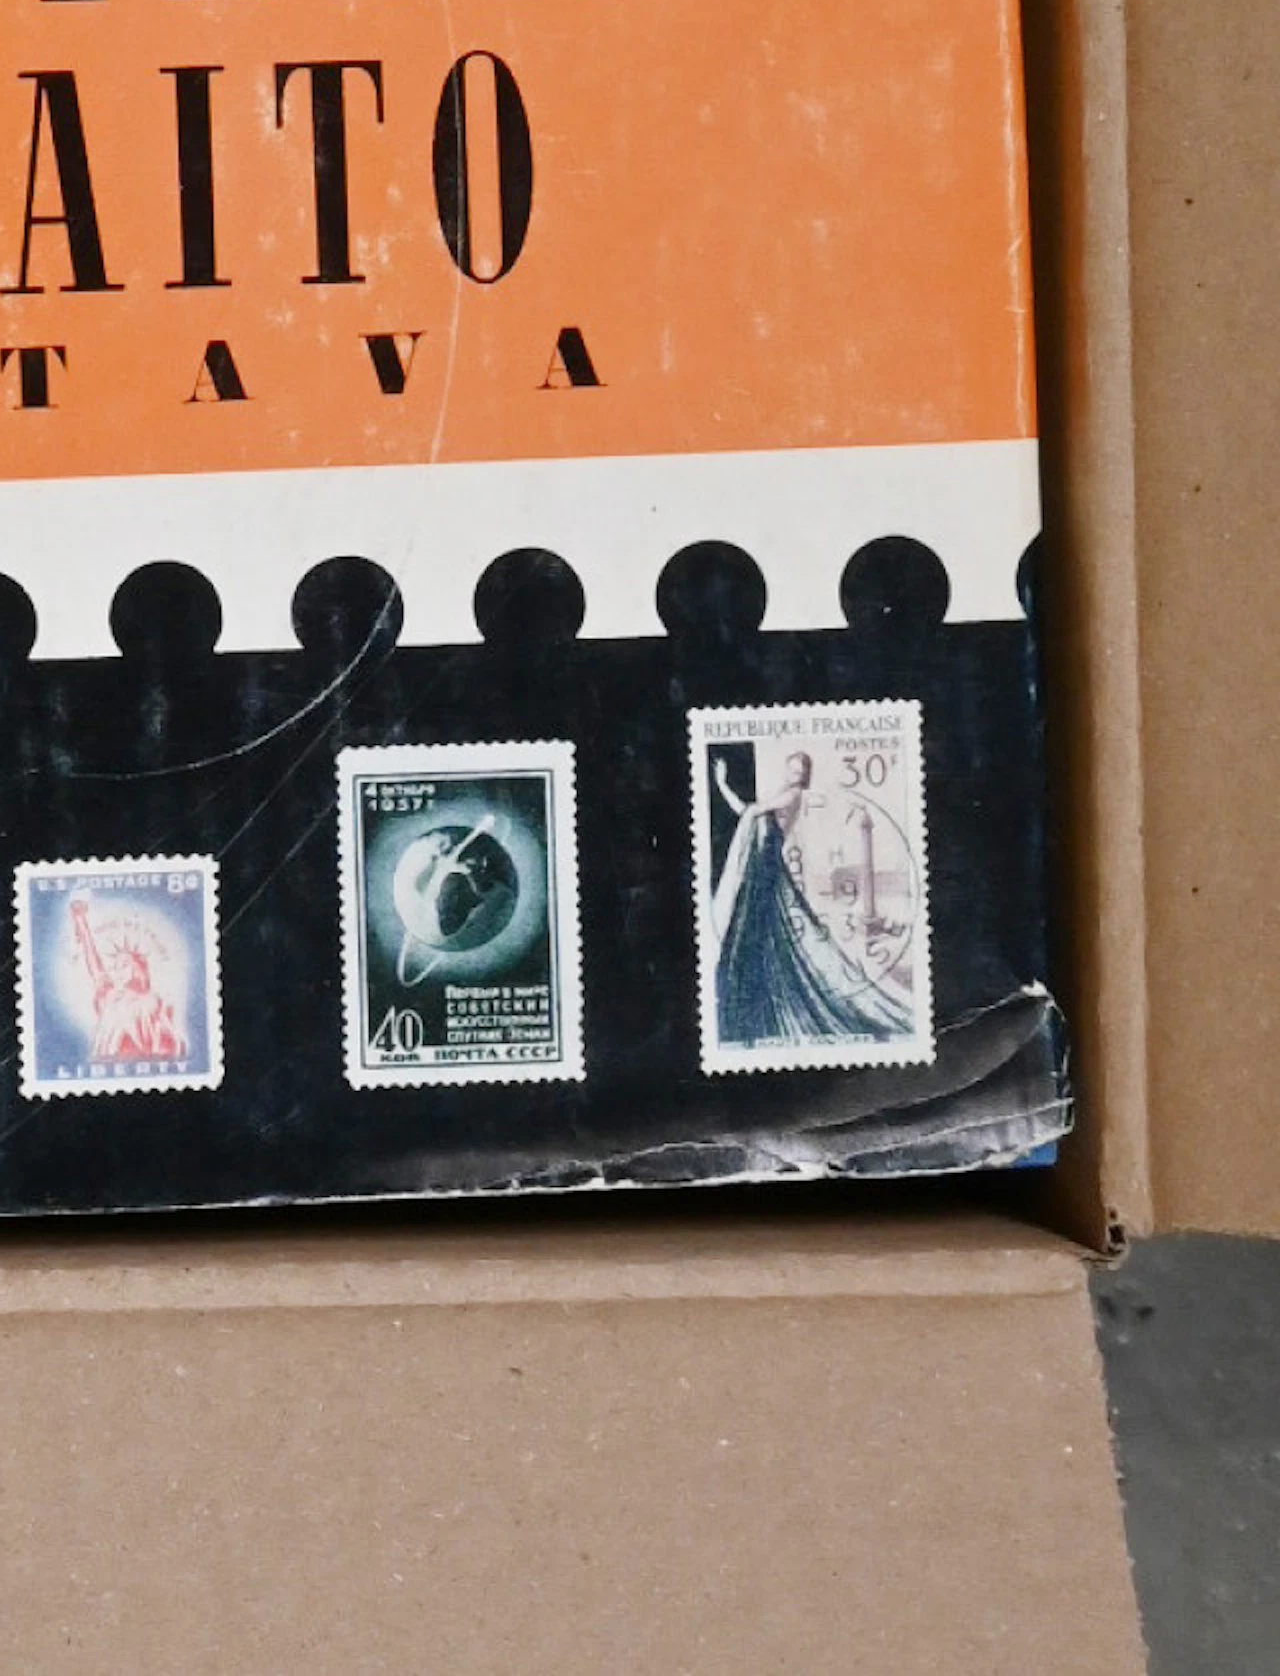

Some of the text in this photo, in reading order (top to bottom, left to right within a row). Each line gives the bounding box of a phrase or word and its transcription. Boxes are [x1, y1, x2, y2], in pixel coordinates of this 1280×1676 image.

[834, 735, 900, 752] POSTES
[75, 874, 162, 891] POSTAGE
[370, 1004, 424, 1052] 40
[505, 1045, 557, 1058] СССР
[56, 1061, 189, 1079] LIBERTY
